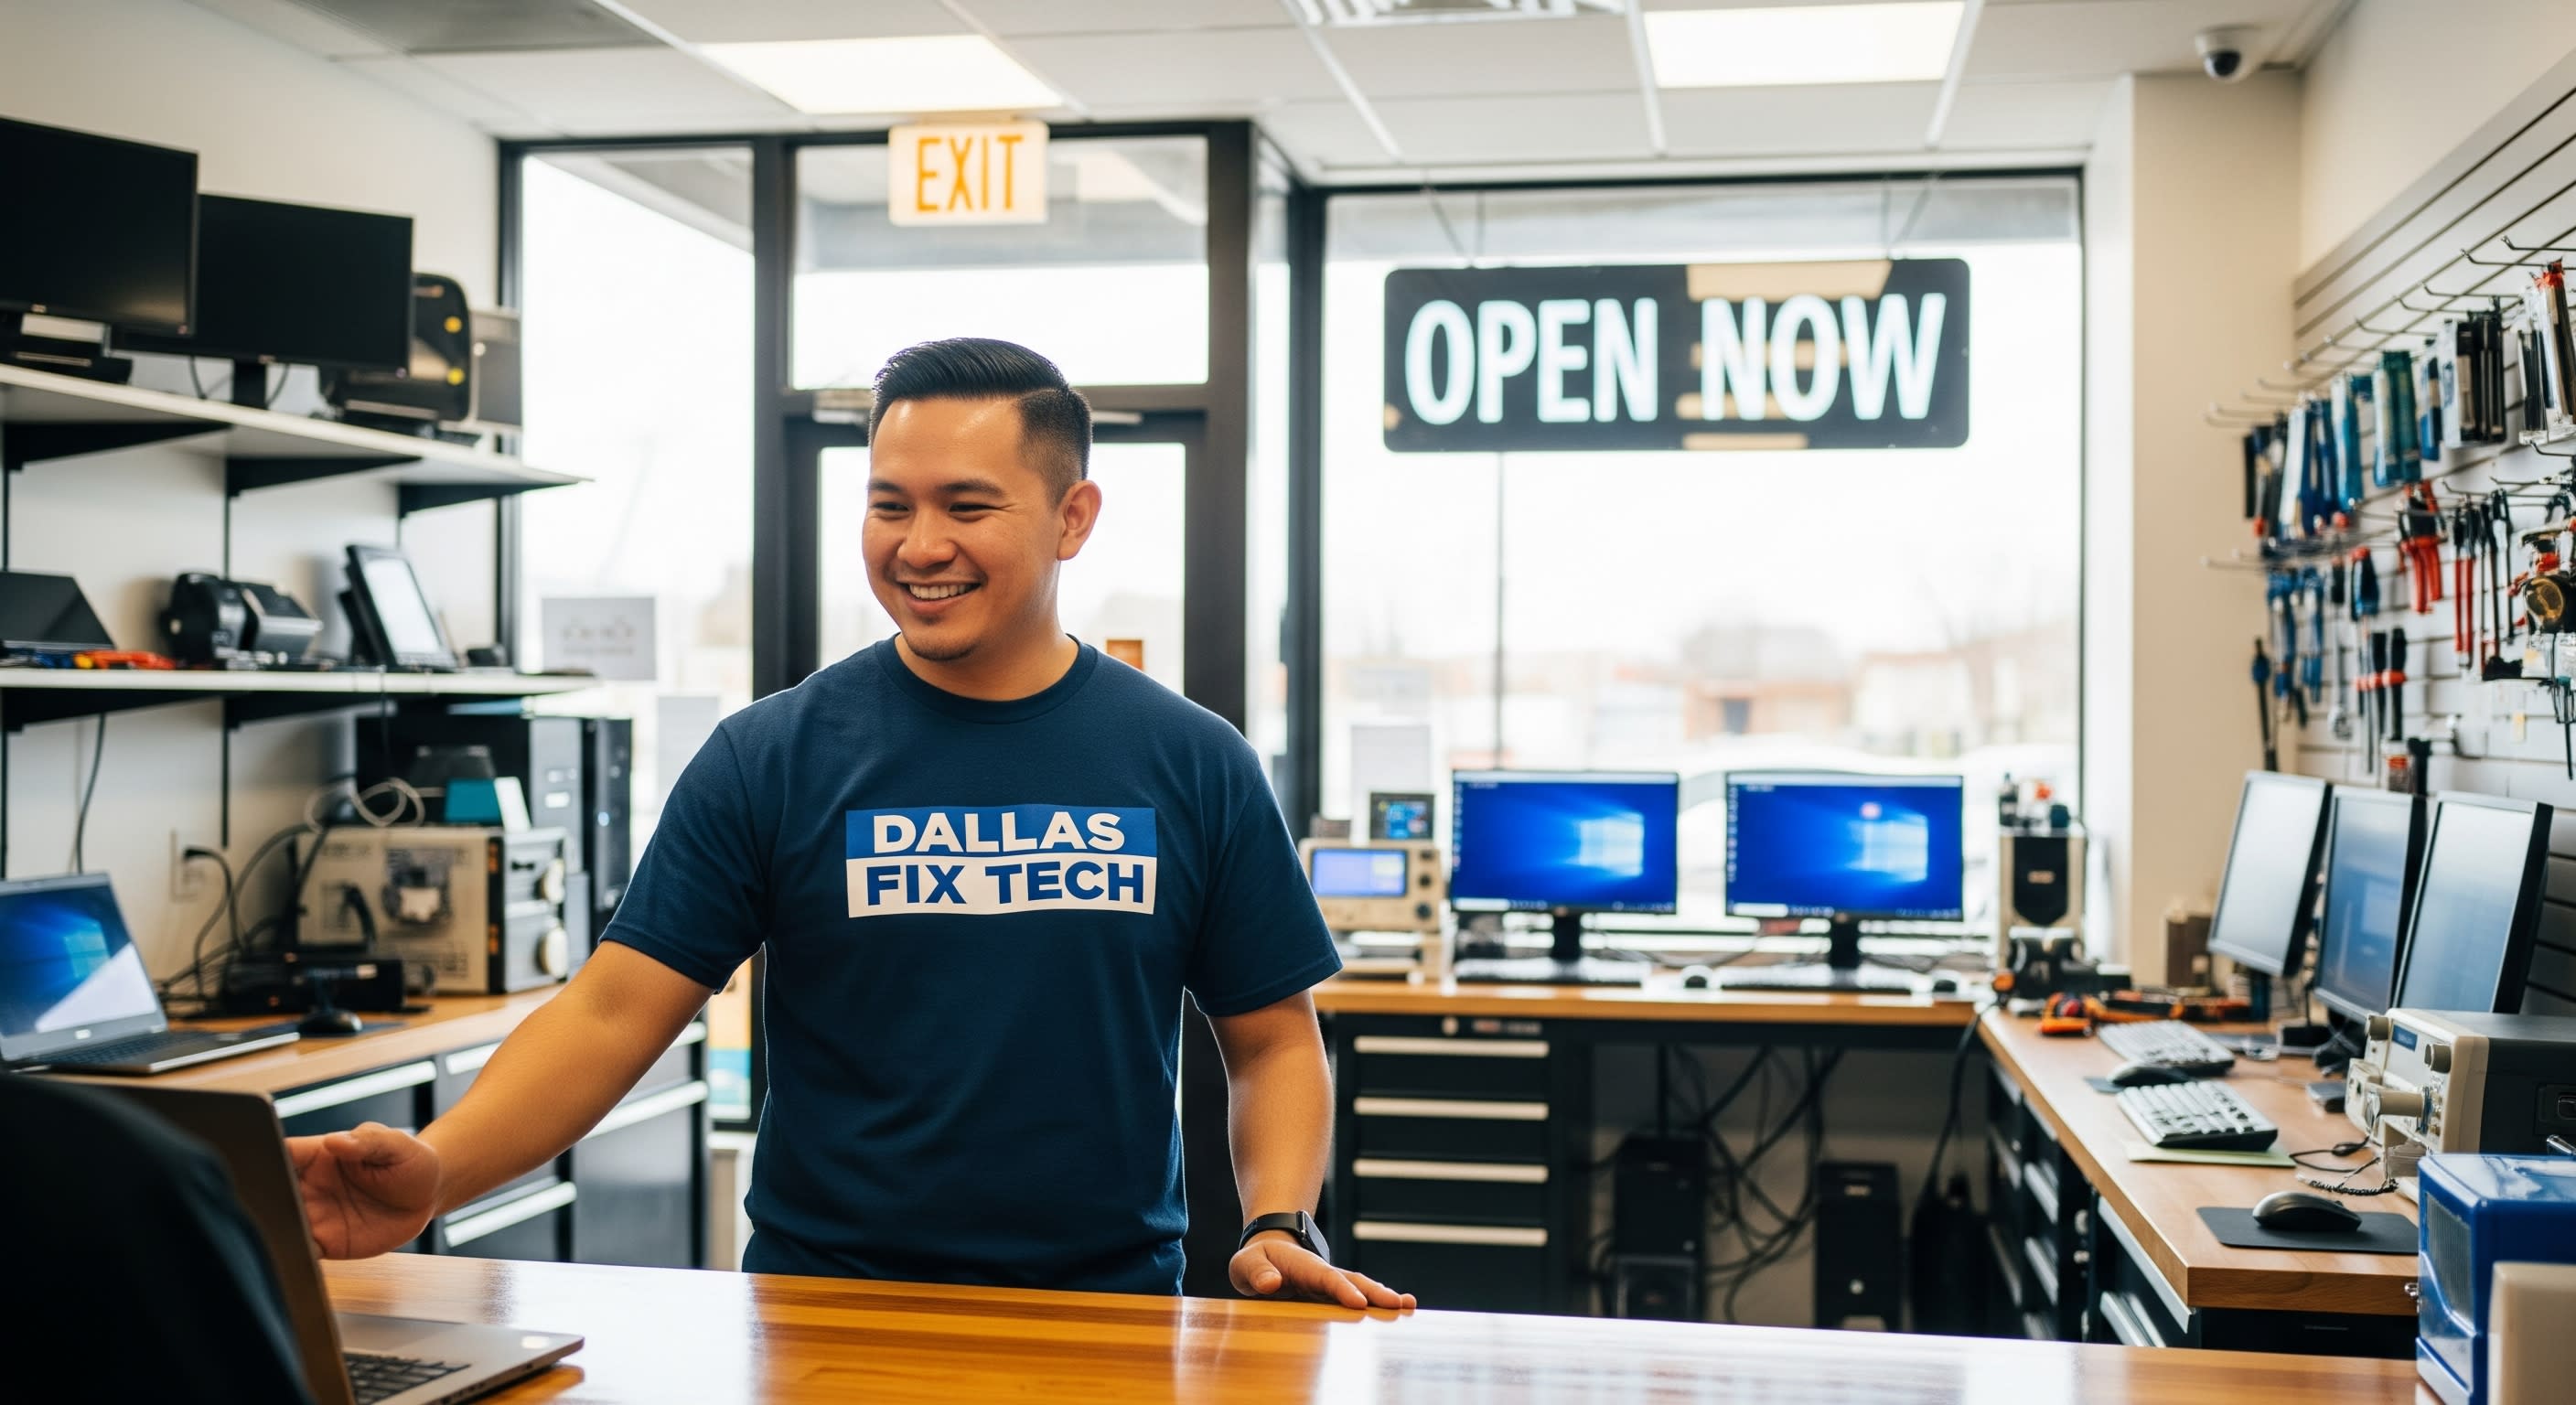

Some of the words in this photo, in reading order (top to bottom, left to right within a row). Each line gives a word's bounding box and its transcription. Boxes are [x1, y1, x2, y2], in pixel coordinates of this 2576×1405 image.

[917, 134, 1024, 211] EXIT
[1405, 297, 1658, 424] OPEN
[1701, 293, 1947, 421] NOW
[874, 811, 1125, 853] DALLAS
[867, 864, 967, 906] FIX
[985, 861, 1144, 905] TECH
